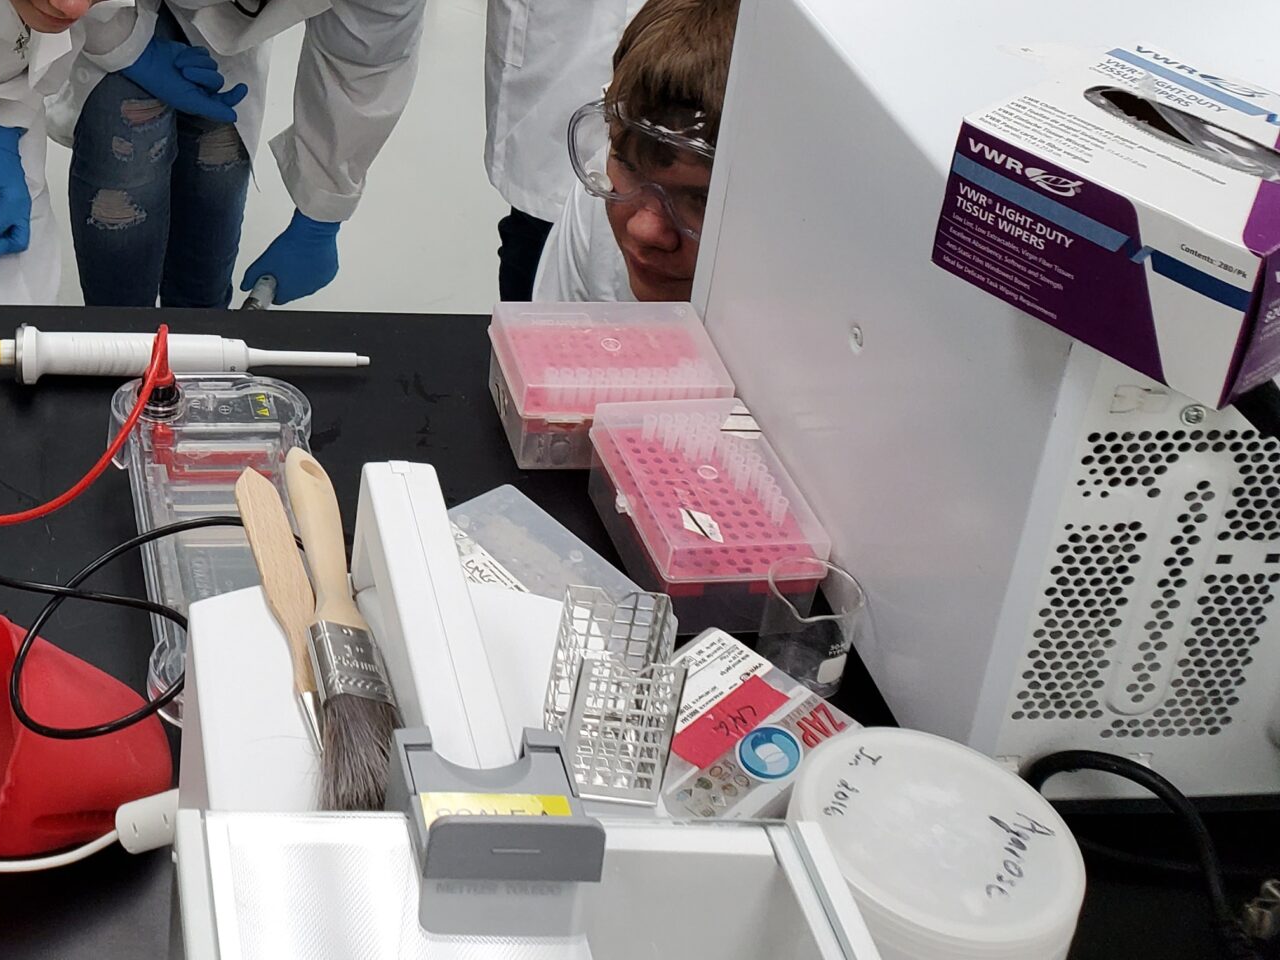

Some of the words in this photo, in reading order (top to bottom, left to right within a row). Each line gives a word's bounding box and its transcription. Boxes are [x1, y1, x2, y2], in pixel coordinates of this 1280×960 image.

[1097, 63, 1138, 84] TISSUE
[1135, 45, 1198, 75] VWR
[968, 137, 1024, 175] VWR
[956, 196, 995, 226] TISSUE
[998, 217, 1045, 251] WIPERS
[995, 202, 1074, 249] LIGHT-DUTY
[1180, 243, 1216, 266] Contents:
[796, 702, 847, 749] ZAP
[985, 811, 1056, 900] Agarose
